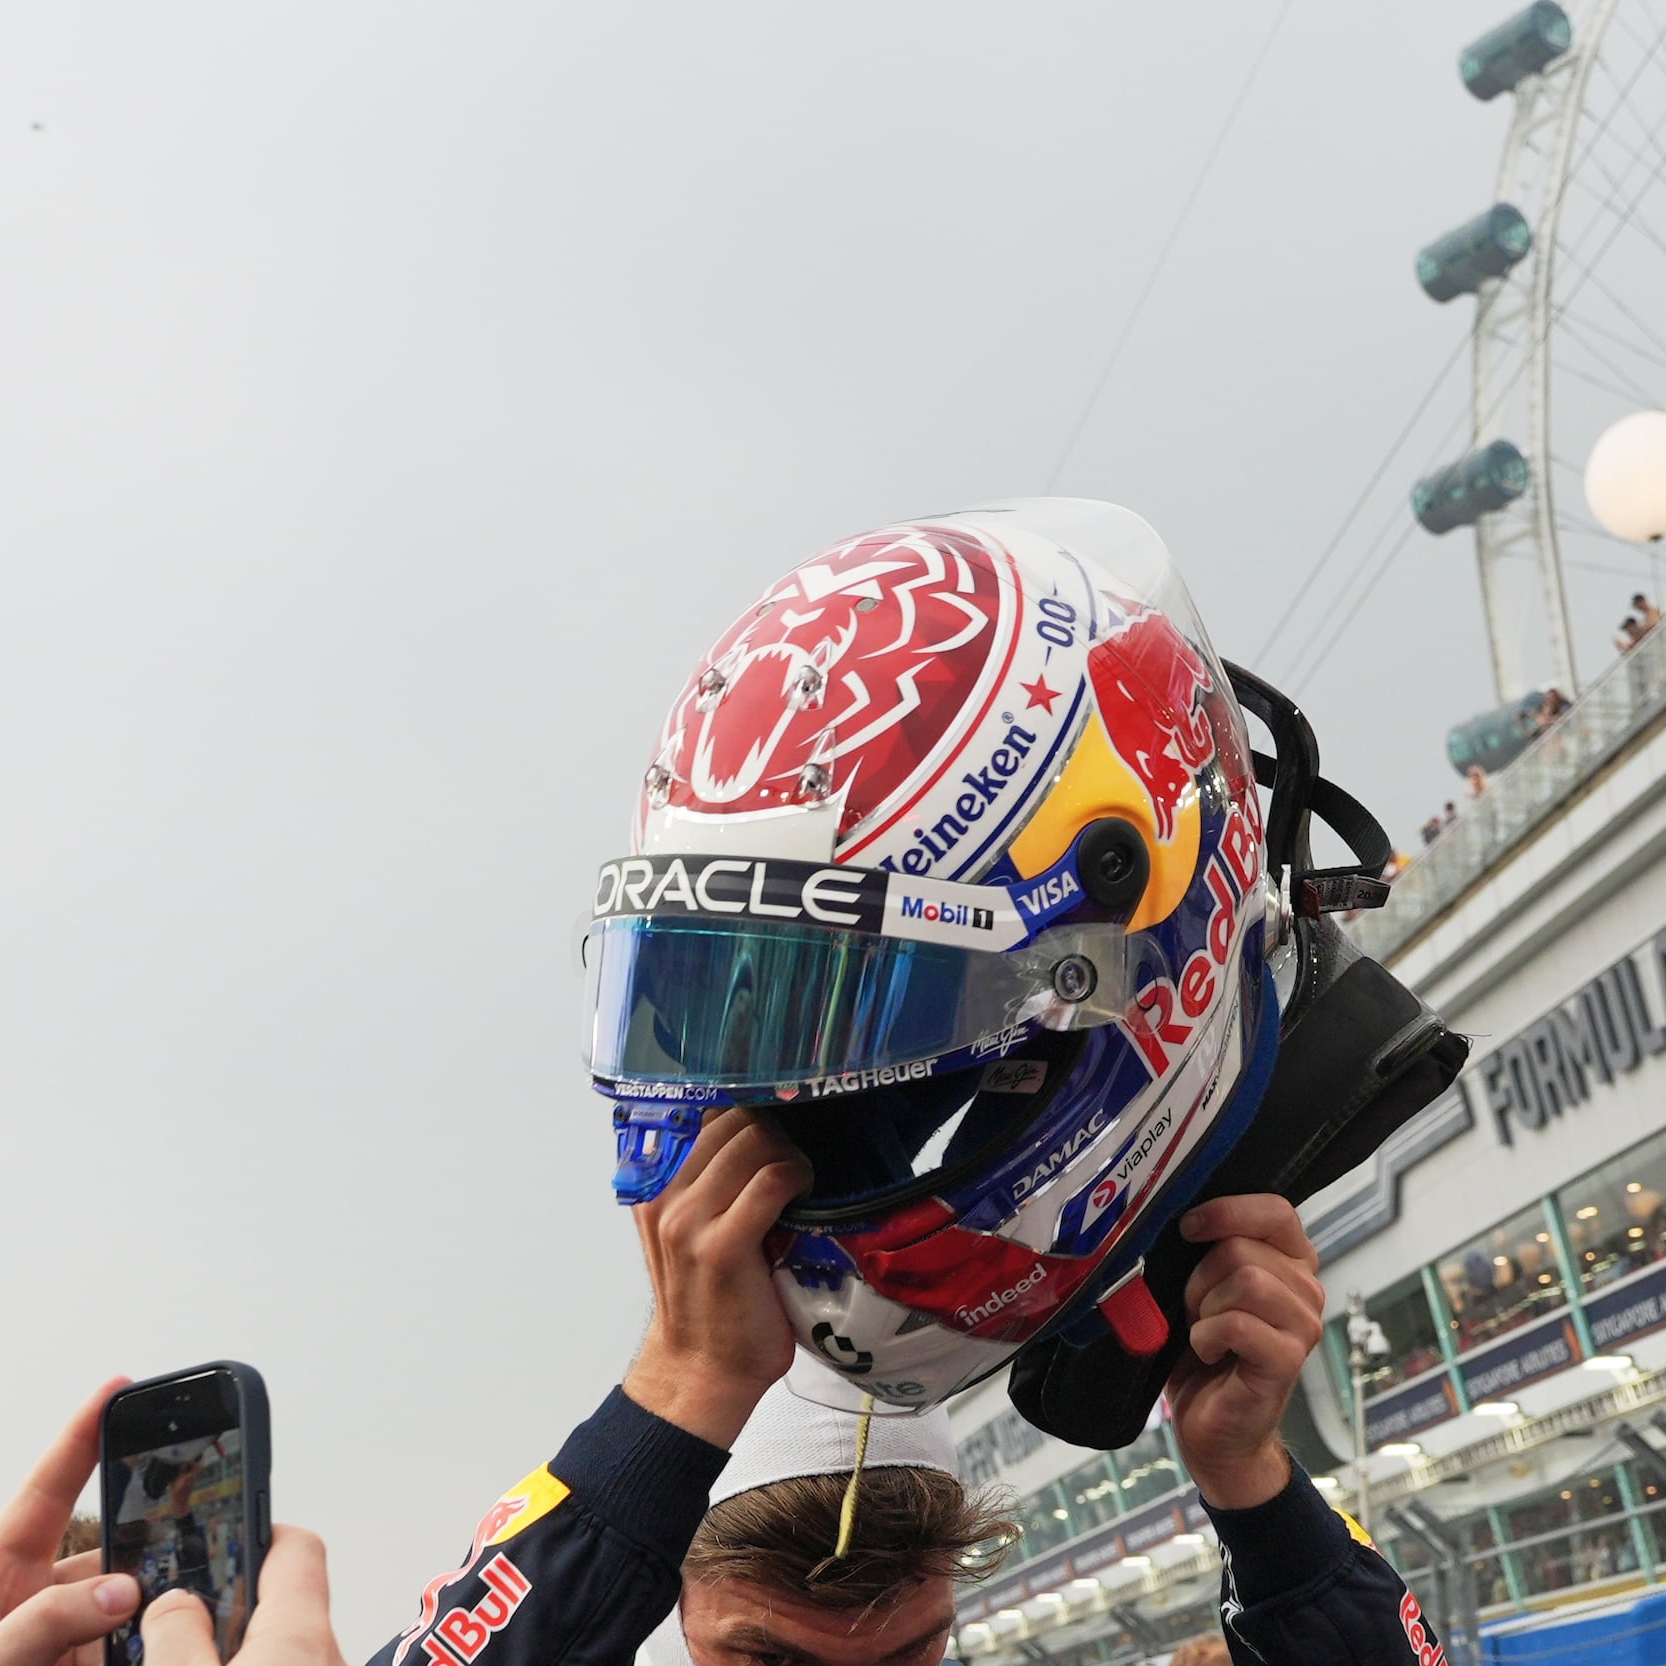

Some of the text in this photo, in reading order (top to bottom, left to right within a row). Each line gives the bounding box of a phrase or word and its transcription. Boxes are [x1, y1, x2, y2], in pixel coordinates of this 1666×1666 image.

[593, 858, 867, 925] ORACLE
[900, 897, 969, 926] Mobil
[1017, 871, 1079, 916] VISA
[1121, 854, 1238, 1078] Red
[1012, 1108, 1106, 1200] DAMAC
[1116, 1108, 1173, 1180] viaplay
[956, 1263, 1048, 1326] indeed
[435, 1551, 533, 1664] Bull
